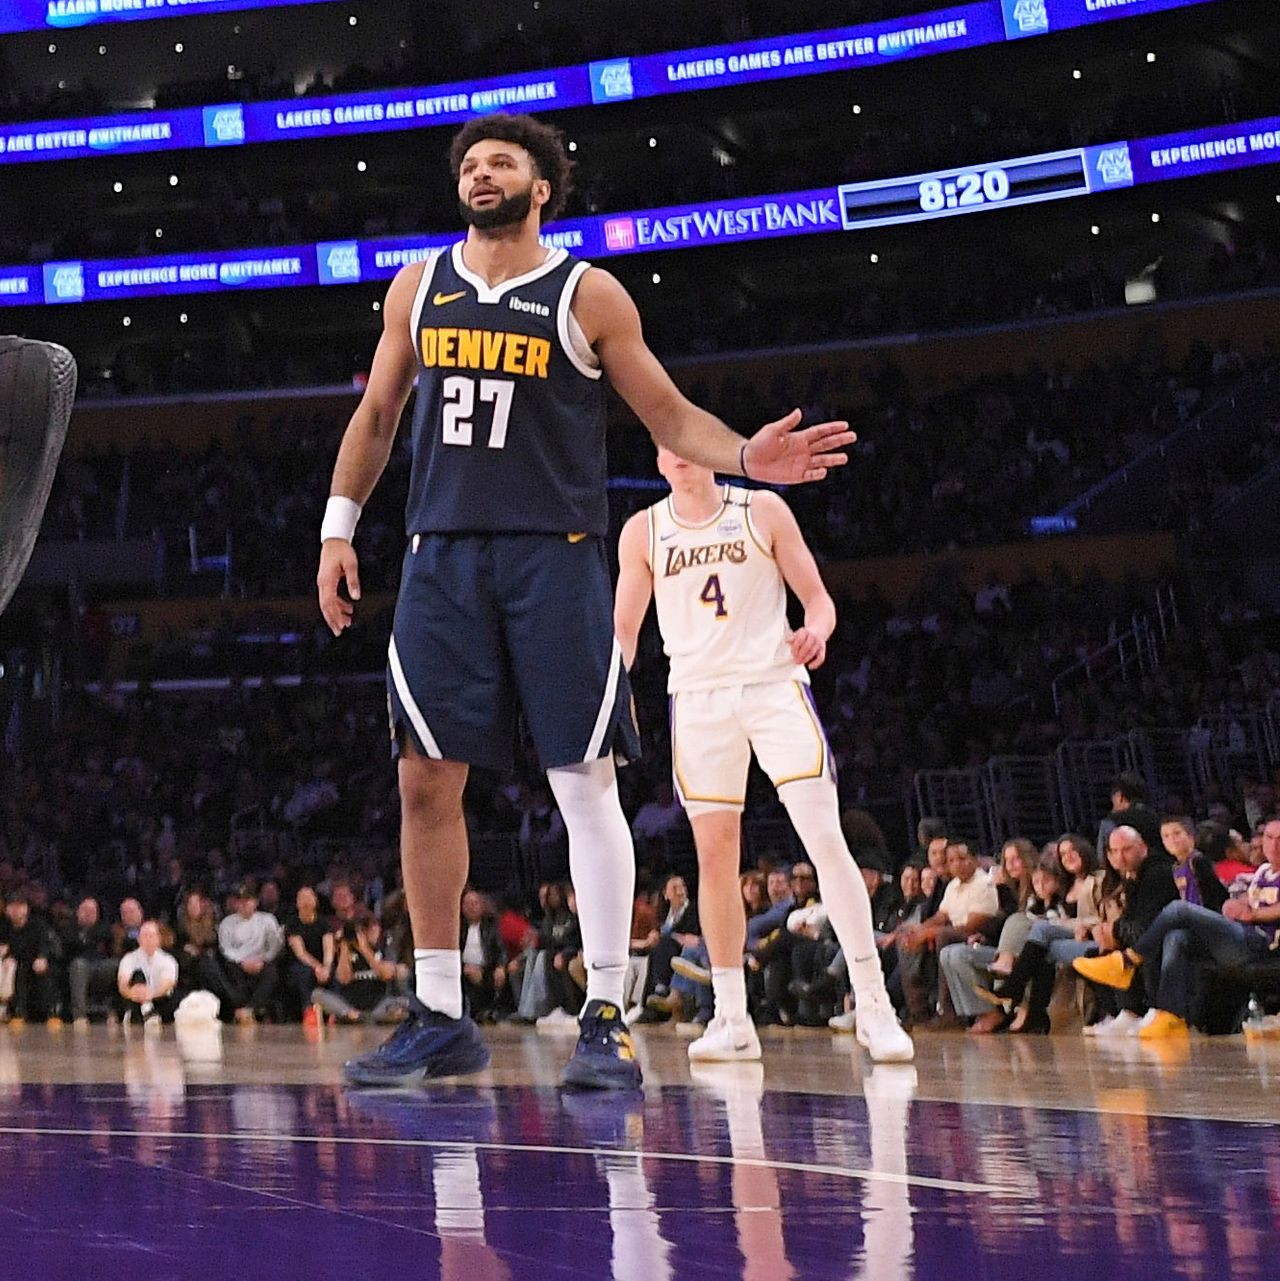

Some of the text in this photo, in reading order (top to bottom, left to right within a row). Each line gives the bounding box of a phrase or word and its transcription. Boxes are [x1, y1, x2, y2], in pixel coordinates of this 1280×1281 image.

[668, 57, 726, 81] LAKERS
[728, 49, 781, 73] GAMES
[784, 43, 815, 65] ARE
[817, 36, 874, 61] BETTER
[277, 107, 332, 130] LAKERS
[334, 103, 384, 125] GAMES
[386, 102, 414, 121] ARE
[416, 96, 469, 118] BETTER
[7, 133, 34, 153] ARE
[1151, 136, 1248, 168] EXPERIENCE
[919, 168, 1010, 212] 8:20
[98, 266, 179, 288] EXPERIENCE
[179, 262, 219, 282] MORE
[509, 297, 550, 317] ibotta
[420, 327, 551, 379] DENVER
[442, 375, 515, 449] 27
[663, 540, 748, 577] LAKERS
[699, 572, 728, 620] 4
